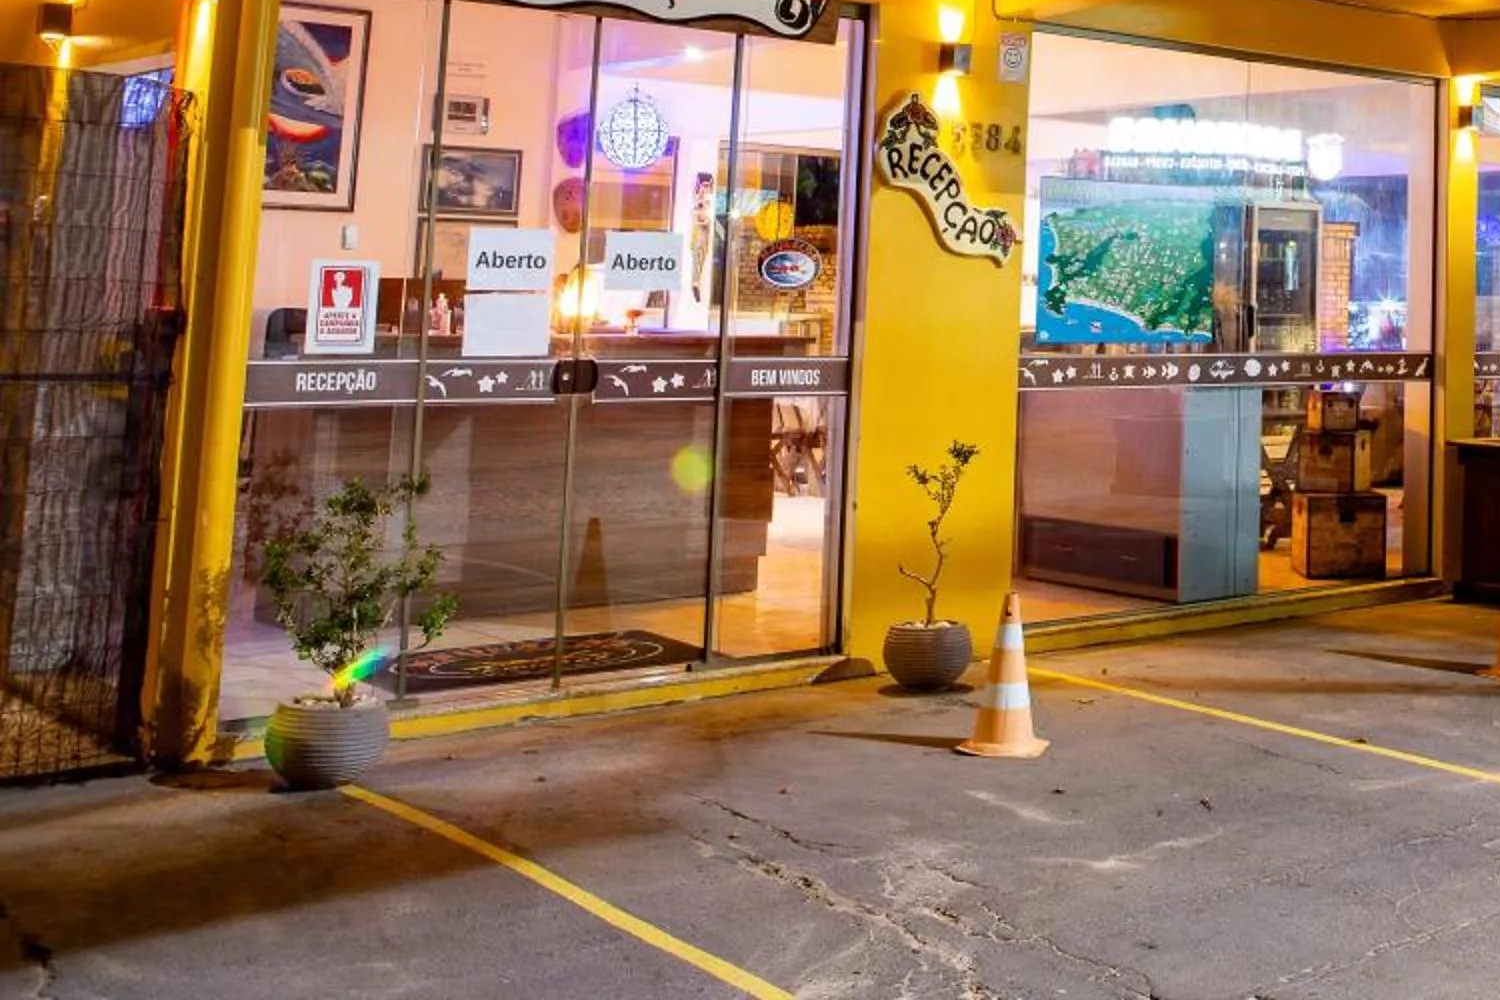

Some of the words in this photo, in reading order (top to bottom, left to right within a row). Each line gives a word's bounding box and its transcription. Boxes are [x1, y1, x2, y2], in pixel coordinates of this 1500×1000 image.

[887, 142, 995, 244] RECEPÇÃO
[475, 251, 546, 269] Aberto
[611, 253, 676, 271] Aberto
[296, 368, 377, 395] RECEPÇÃO
[751, 369, 777, 387] BEM
[779, 368, 821, 386] VINDOS
